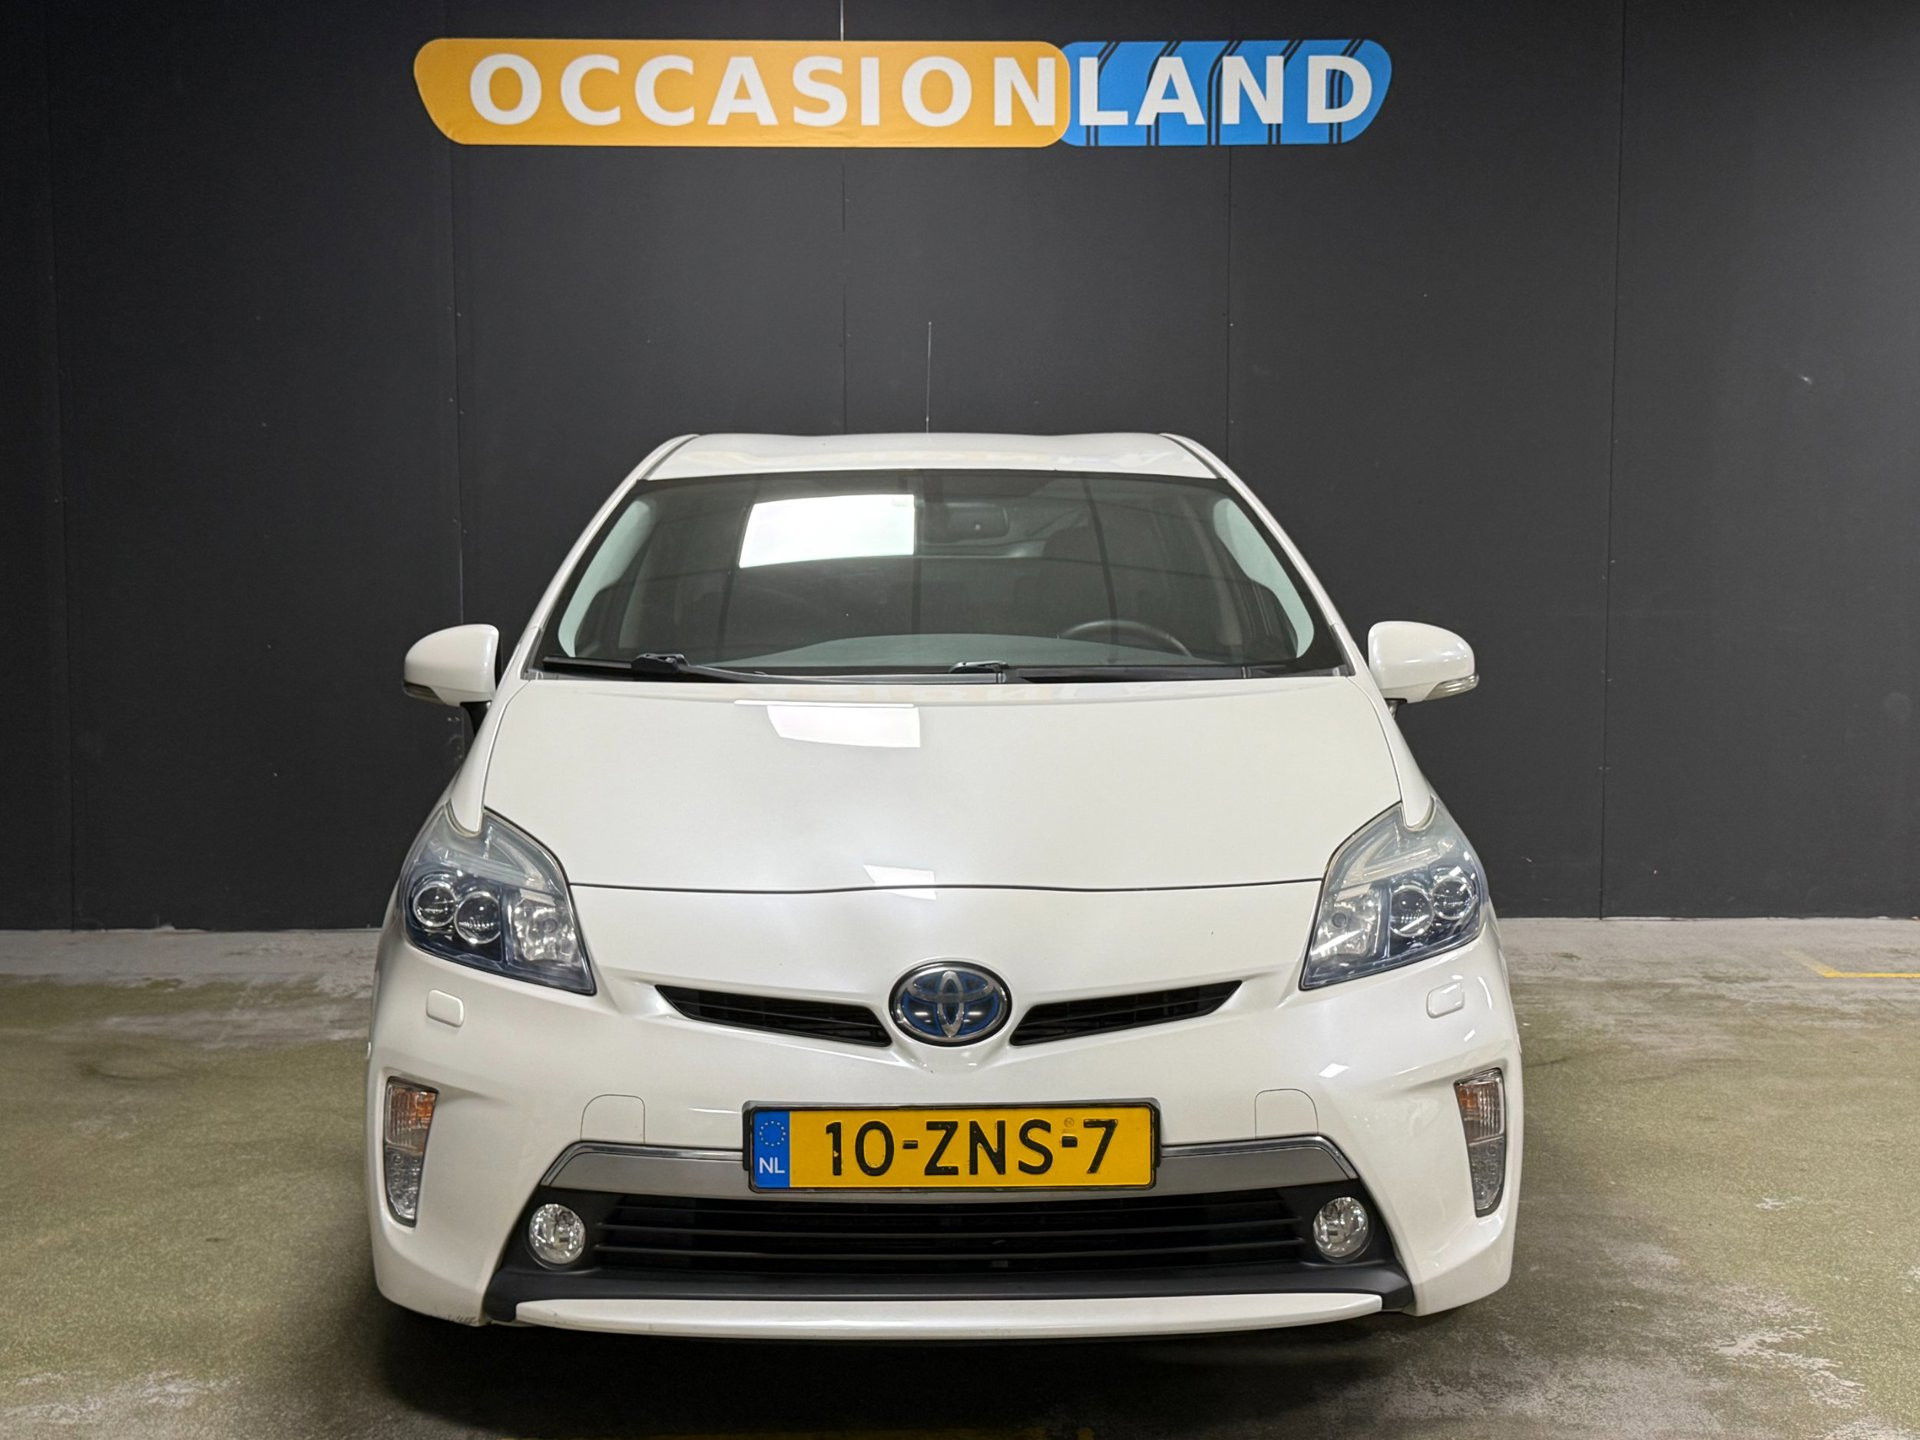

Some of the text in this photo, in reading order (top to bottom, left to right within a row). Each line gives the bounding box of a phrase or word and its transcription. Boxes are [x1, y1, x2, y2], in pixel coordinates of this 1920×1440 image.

[469, 52, 1373, 128] OCCASIONLAND
[758, 1157, 786, 1175] NL
[825, 1118, 1119, 1177] 10-ZNS-7
